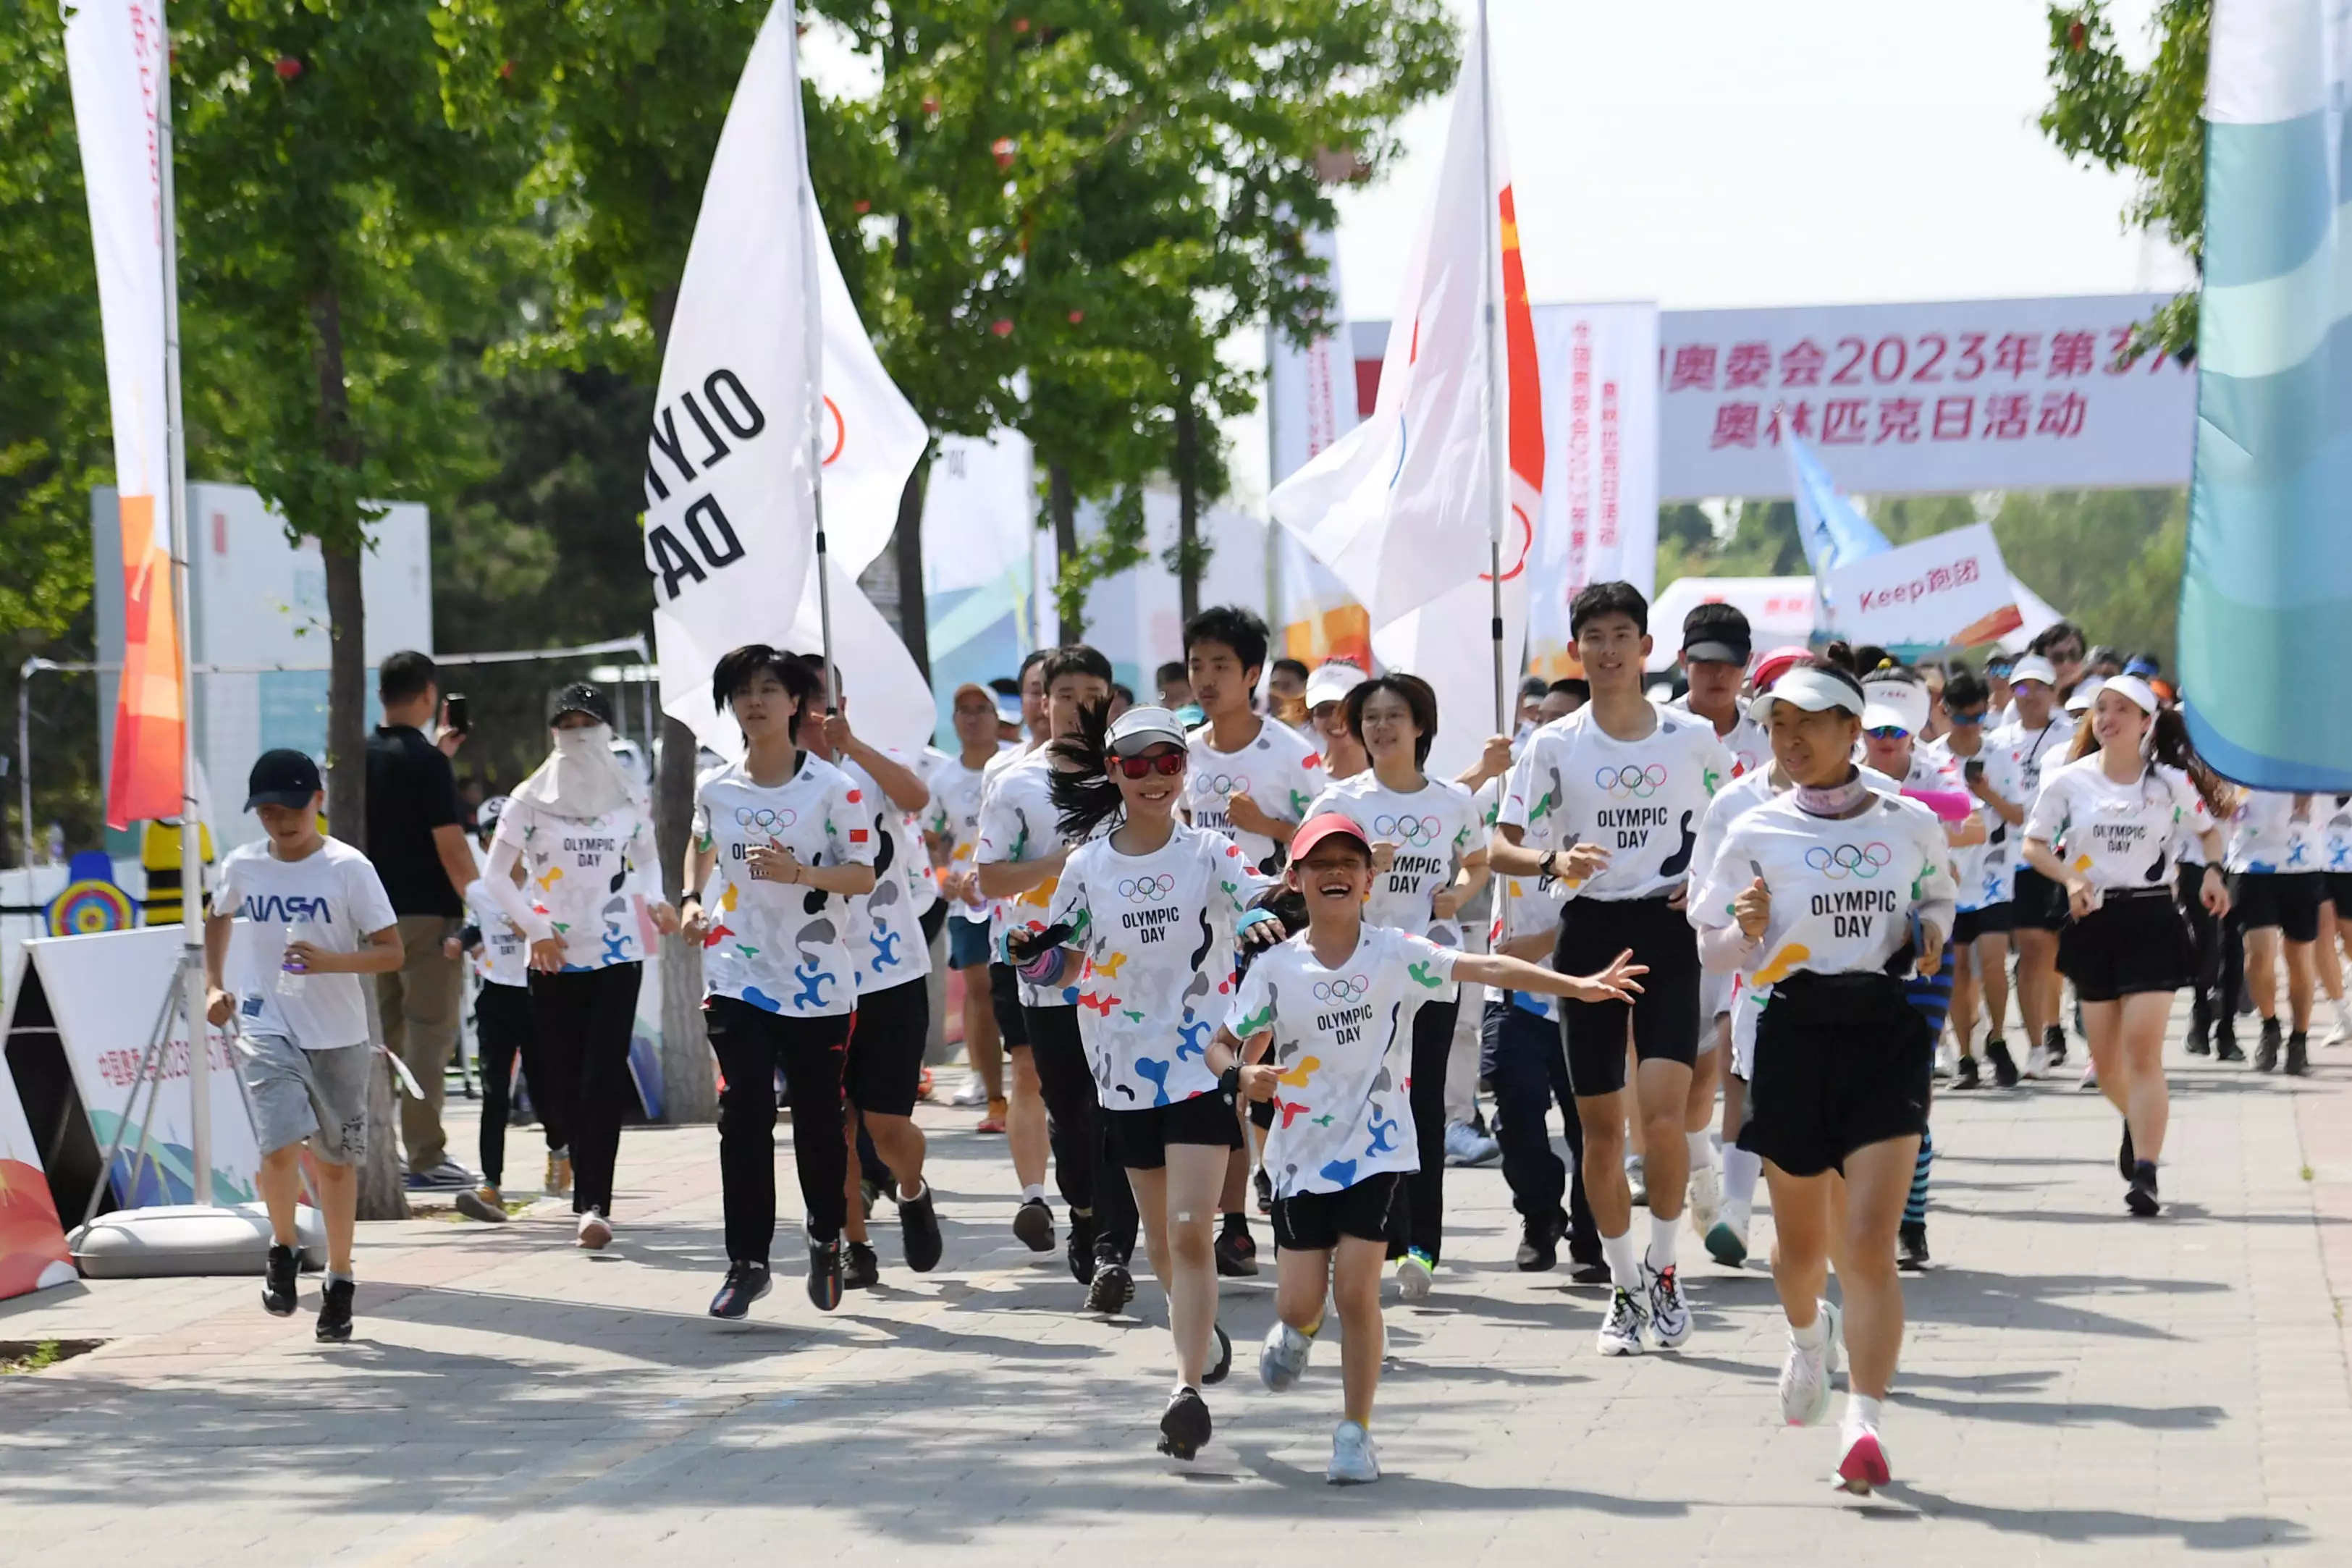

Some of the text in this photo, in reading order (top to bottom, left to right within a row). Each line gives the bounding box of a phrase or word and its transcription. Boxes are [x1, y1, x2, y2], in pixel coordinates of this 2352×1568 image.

[1709, 389, 2089, 452] 奥林匹克日活动
[1858, 557, 1981, 614] Keep跑团
[1598, 806, 1667, 827] OLYMPIC
[1617, 830, 1648, 849] DAY
[2093, 824, 2146, 840] OLYMPIC
[563, 838, 615, 851] OLYMPIC
[2107, 840, 2132, 854] DAY
[578, 853, 601, 867] DAY
[1385, 856, 1441, 874] YMPIC
[1388, 874, 1420, 894] DAY
[247, 895, 332, 924] NASA
[1811, 890, 1896, 916] OLYMPIC
[1122, 906, 1179, 929] OLYMPIC
[1834, 915, 1873, 937] DAY
[1140, 926, 1166, 944] DAY
[1317, 1003, 1373, 1031] OLYMPIC
[1336, 1025, 1360, 1045] DAY
